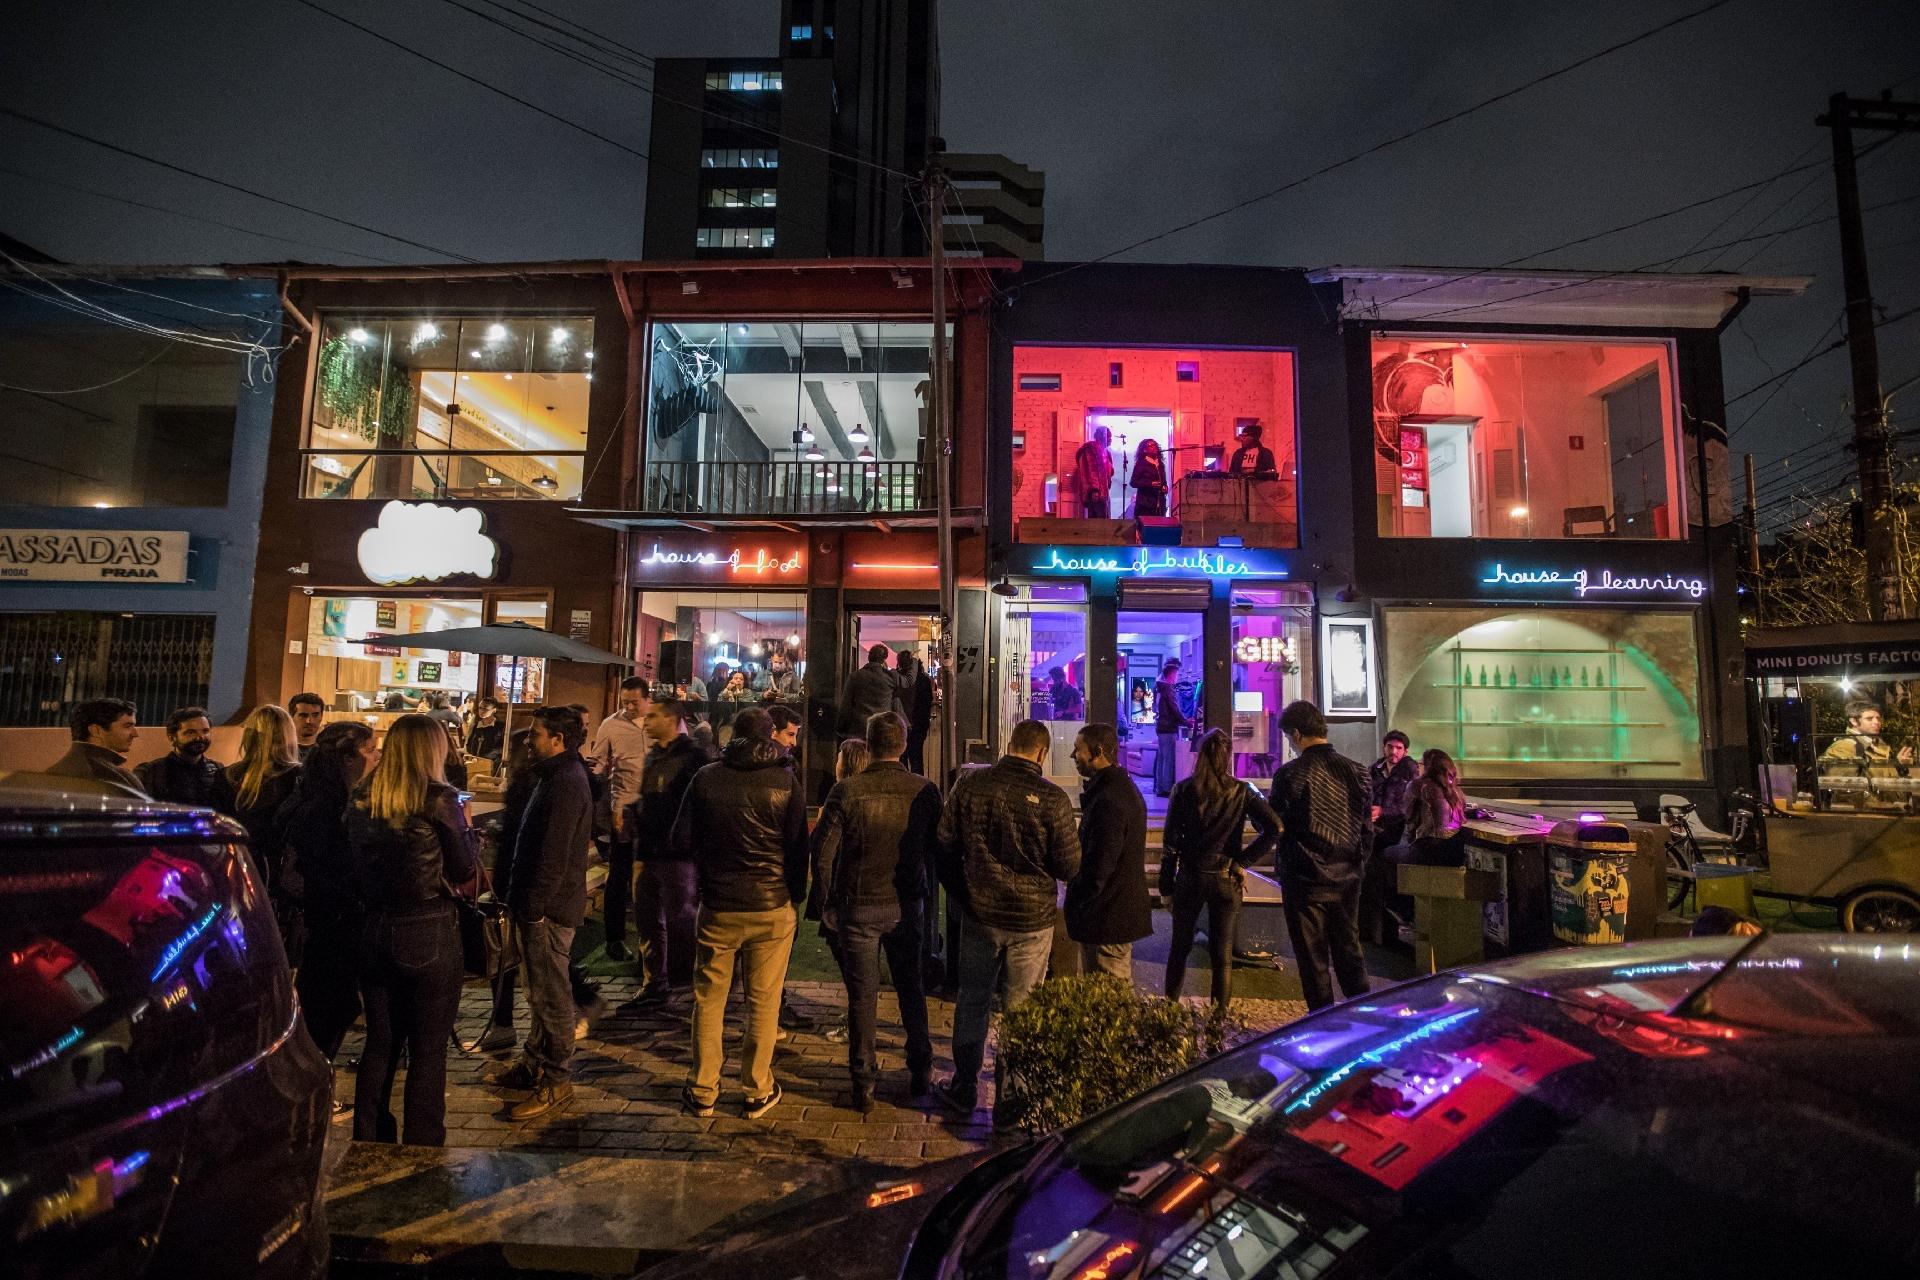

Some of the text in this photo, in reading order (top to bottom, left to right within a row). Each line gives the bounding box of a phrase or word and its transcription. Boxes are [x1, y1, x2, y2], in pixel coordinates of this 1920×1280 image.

[641, 544, 717, 564] house
[756, 549, 801, 574] food
[1033, 550, 1119, 571] house
[1132, 548, 1148, 576] of
[101, 568, 159, 578] PRAIA
[1485, 564, 1562, 583] house
[1602, 570, 1706, 597] learning
[1236, 636, 1297, 662] GIN
[1757, 657, 1793, 669] MINI
[1797, 653, 1863, 668] DONUTS
